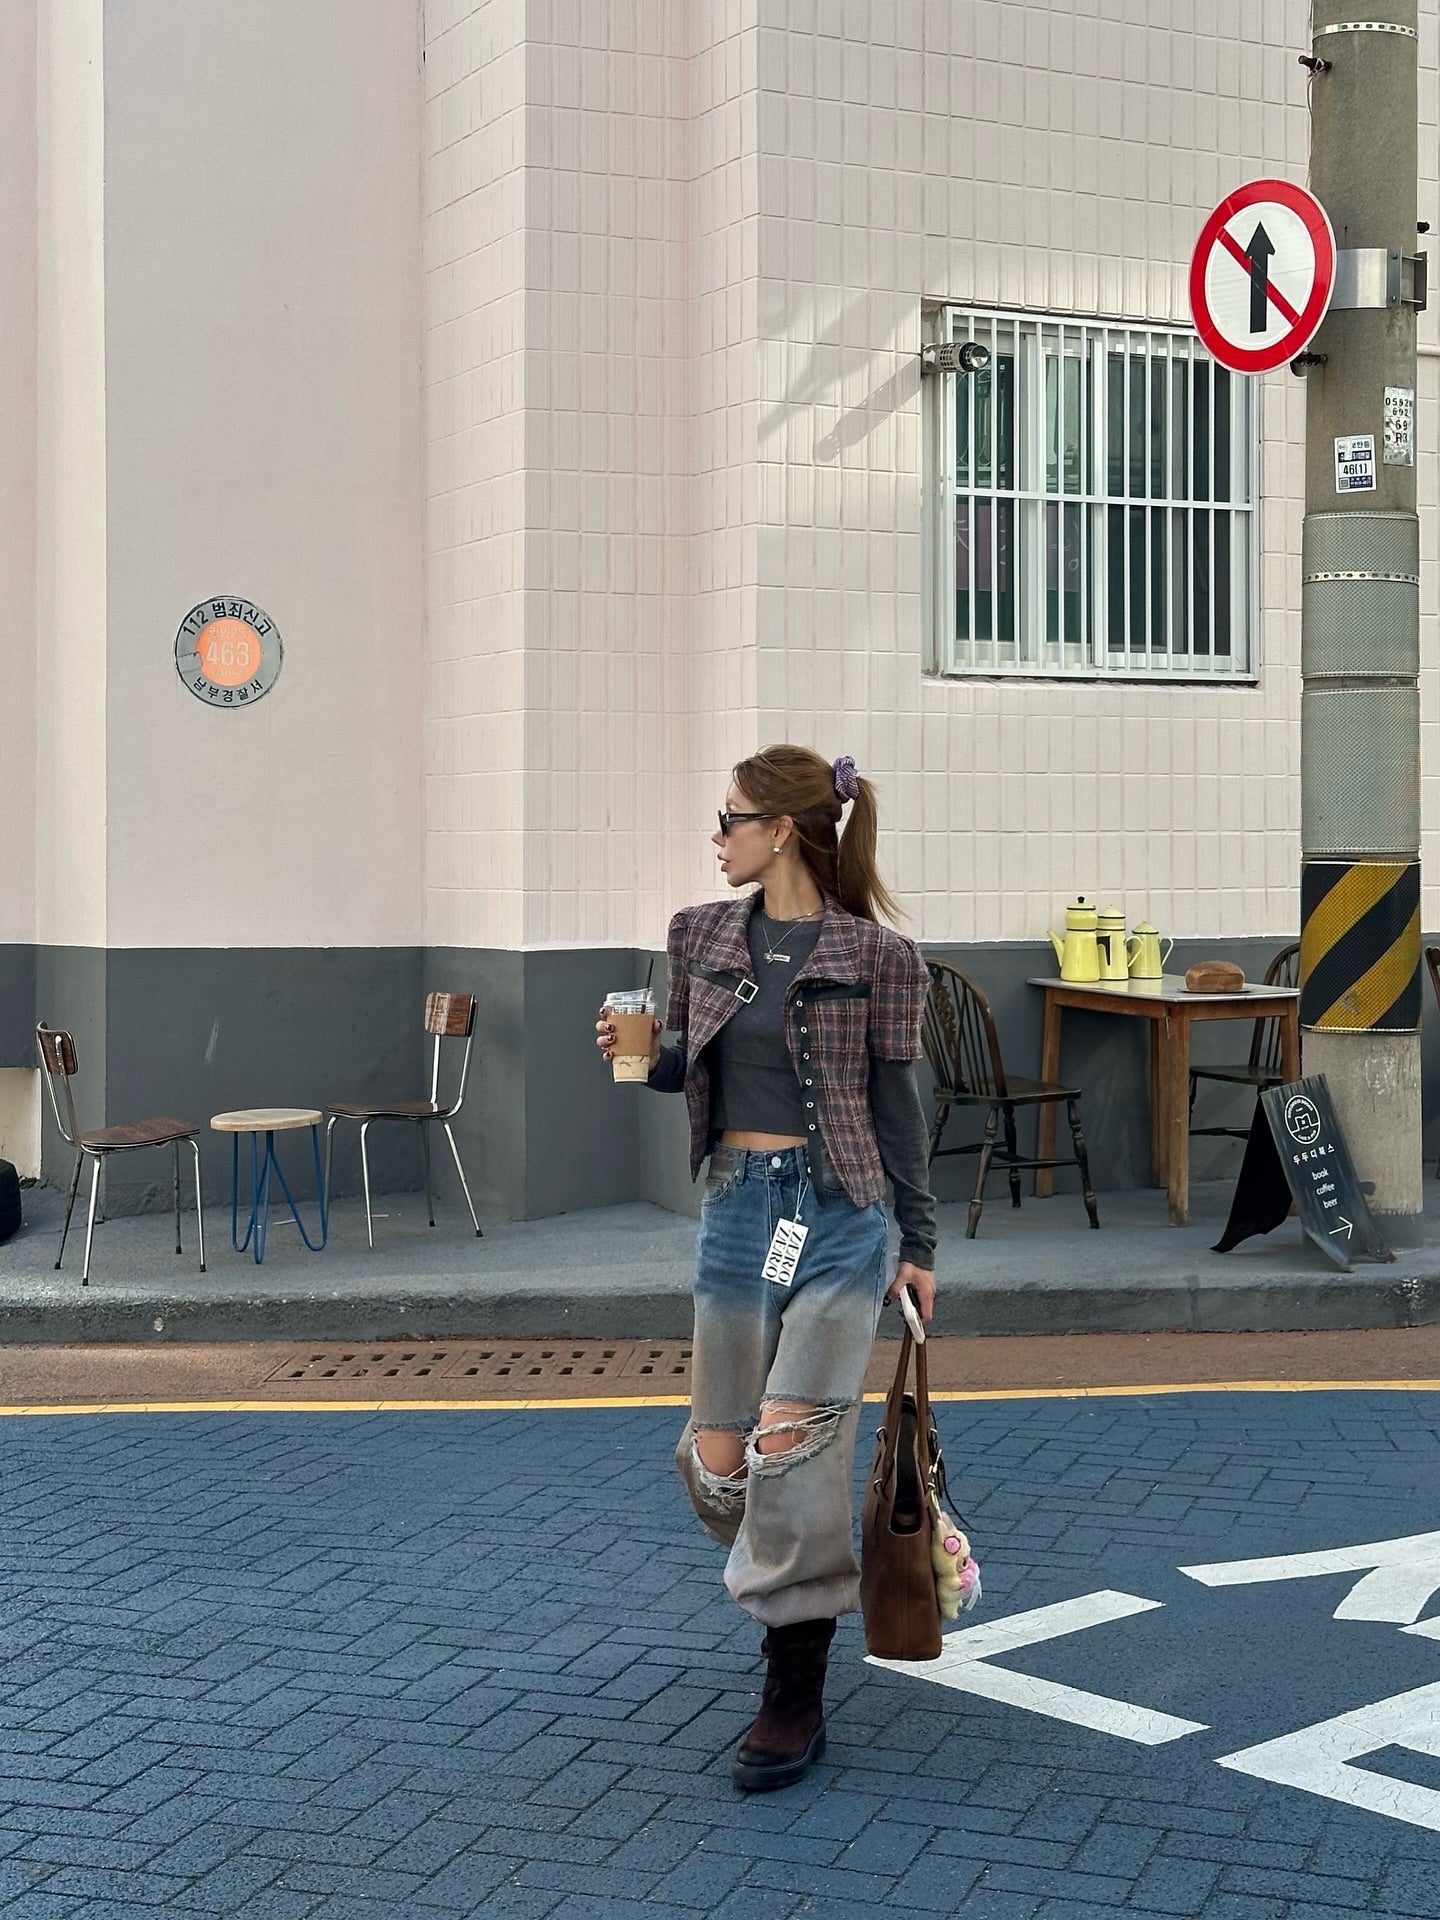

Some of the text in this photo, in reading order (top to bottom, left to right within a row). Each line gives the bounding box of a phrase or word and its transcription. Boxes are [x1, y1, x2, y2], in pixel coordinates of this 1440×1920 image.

[1343, 463, 1367, 475] 46(1)
[183, 601, 272, 637] 112 범죄신고
[206, 641, 249, 666] 463
[1312, 1168, 1329, 1180] book
[1316, 1183, 1335, 1195] coffee
[1323, 1198, 1338, 1209] beer
